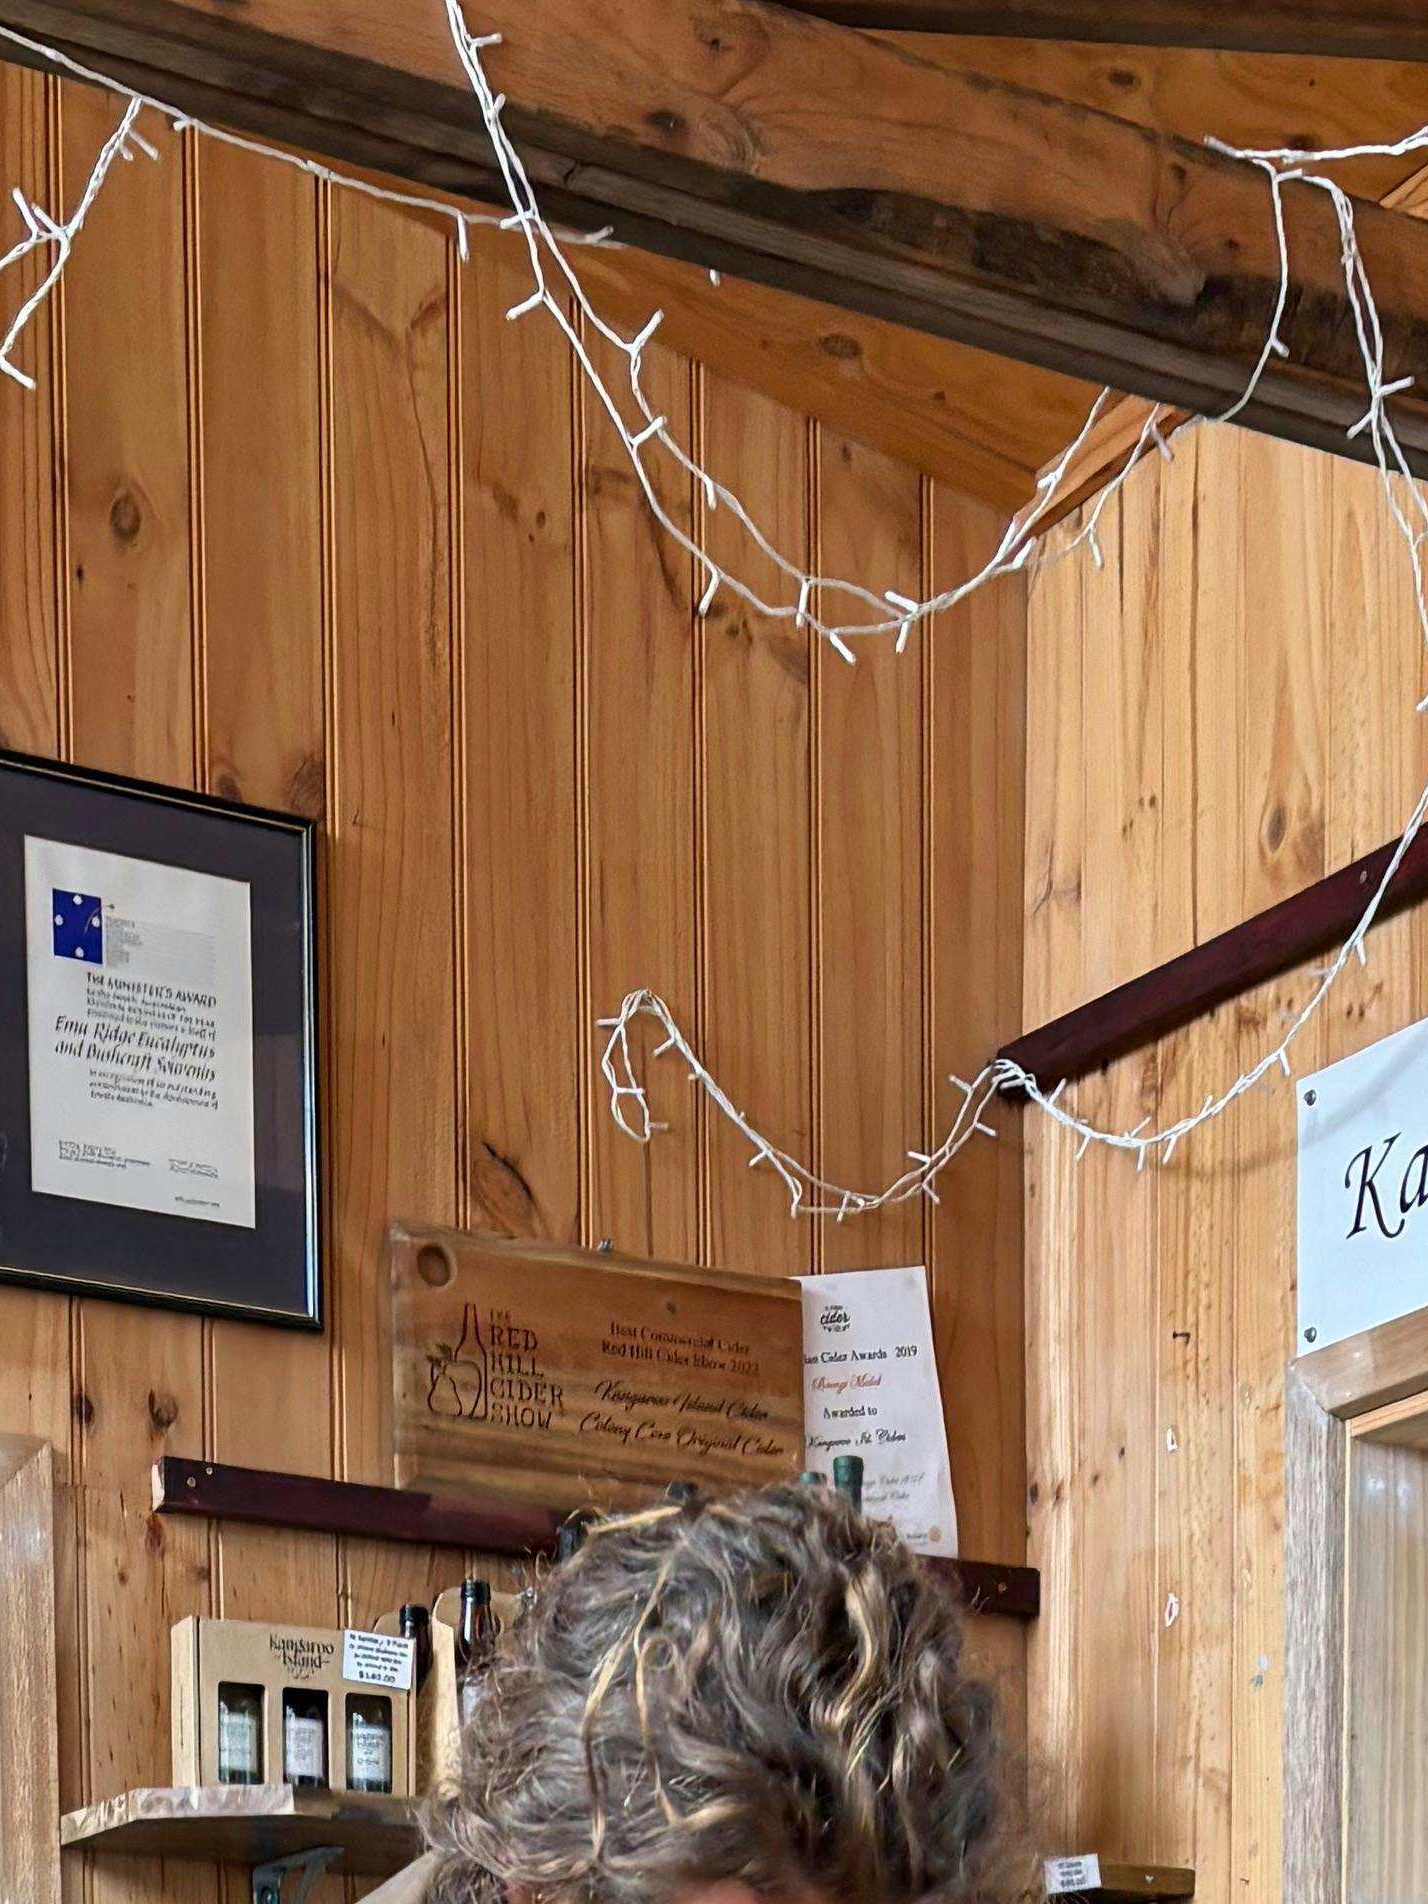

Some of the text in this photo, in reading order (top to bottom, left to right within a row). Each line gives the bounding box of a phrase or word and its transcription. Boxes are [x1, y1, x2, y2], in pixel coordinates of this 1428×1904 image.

[54, 1014, 90, 1037] Emu
[54, 1039, 84, 1059] and
[820, 1310, 851, 1326] cider
[490, 1325, 539, 1352] RED
[601, 1338, 627, 1358] Red
[894, 1344, 918, 1360] 2019
[490, 1377, 565, 1417] CIDER
[490, 1402, 553, 1430] SHOW
[822, 1404, 878, 1421] Awarded to
[579, 1410, 632, 1442] Colony
